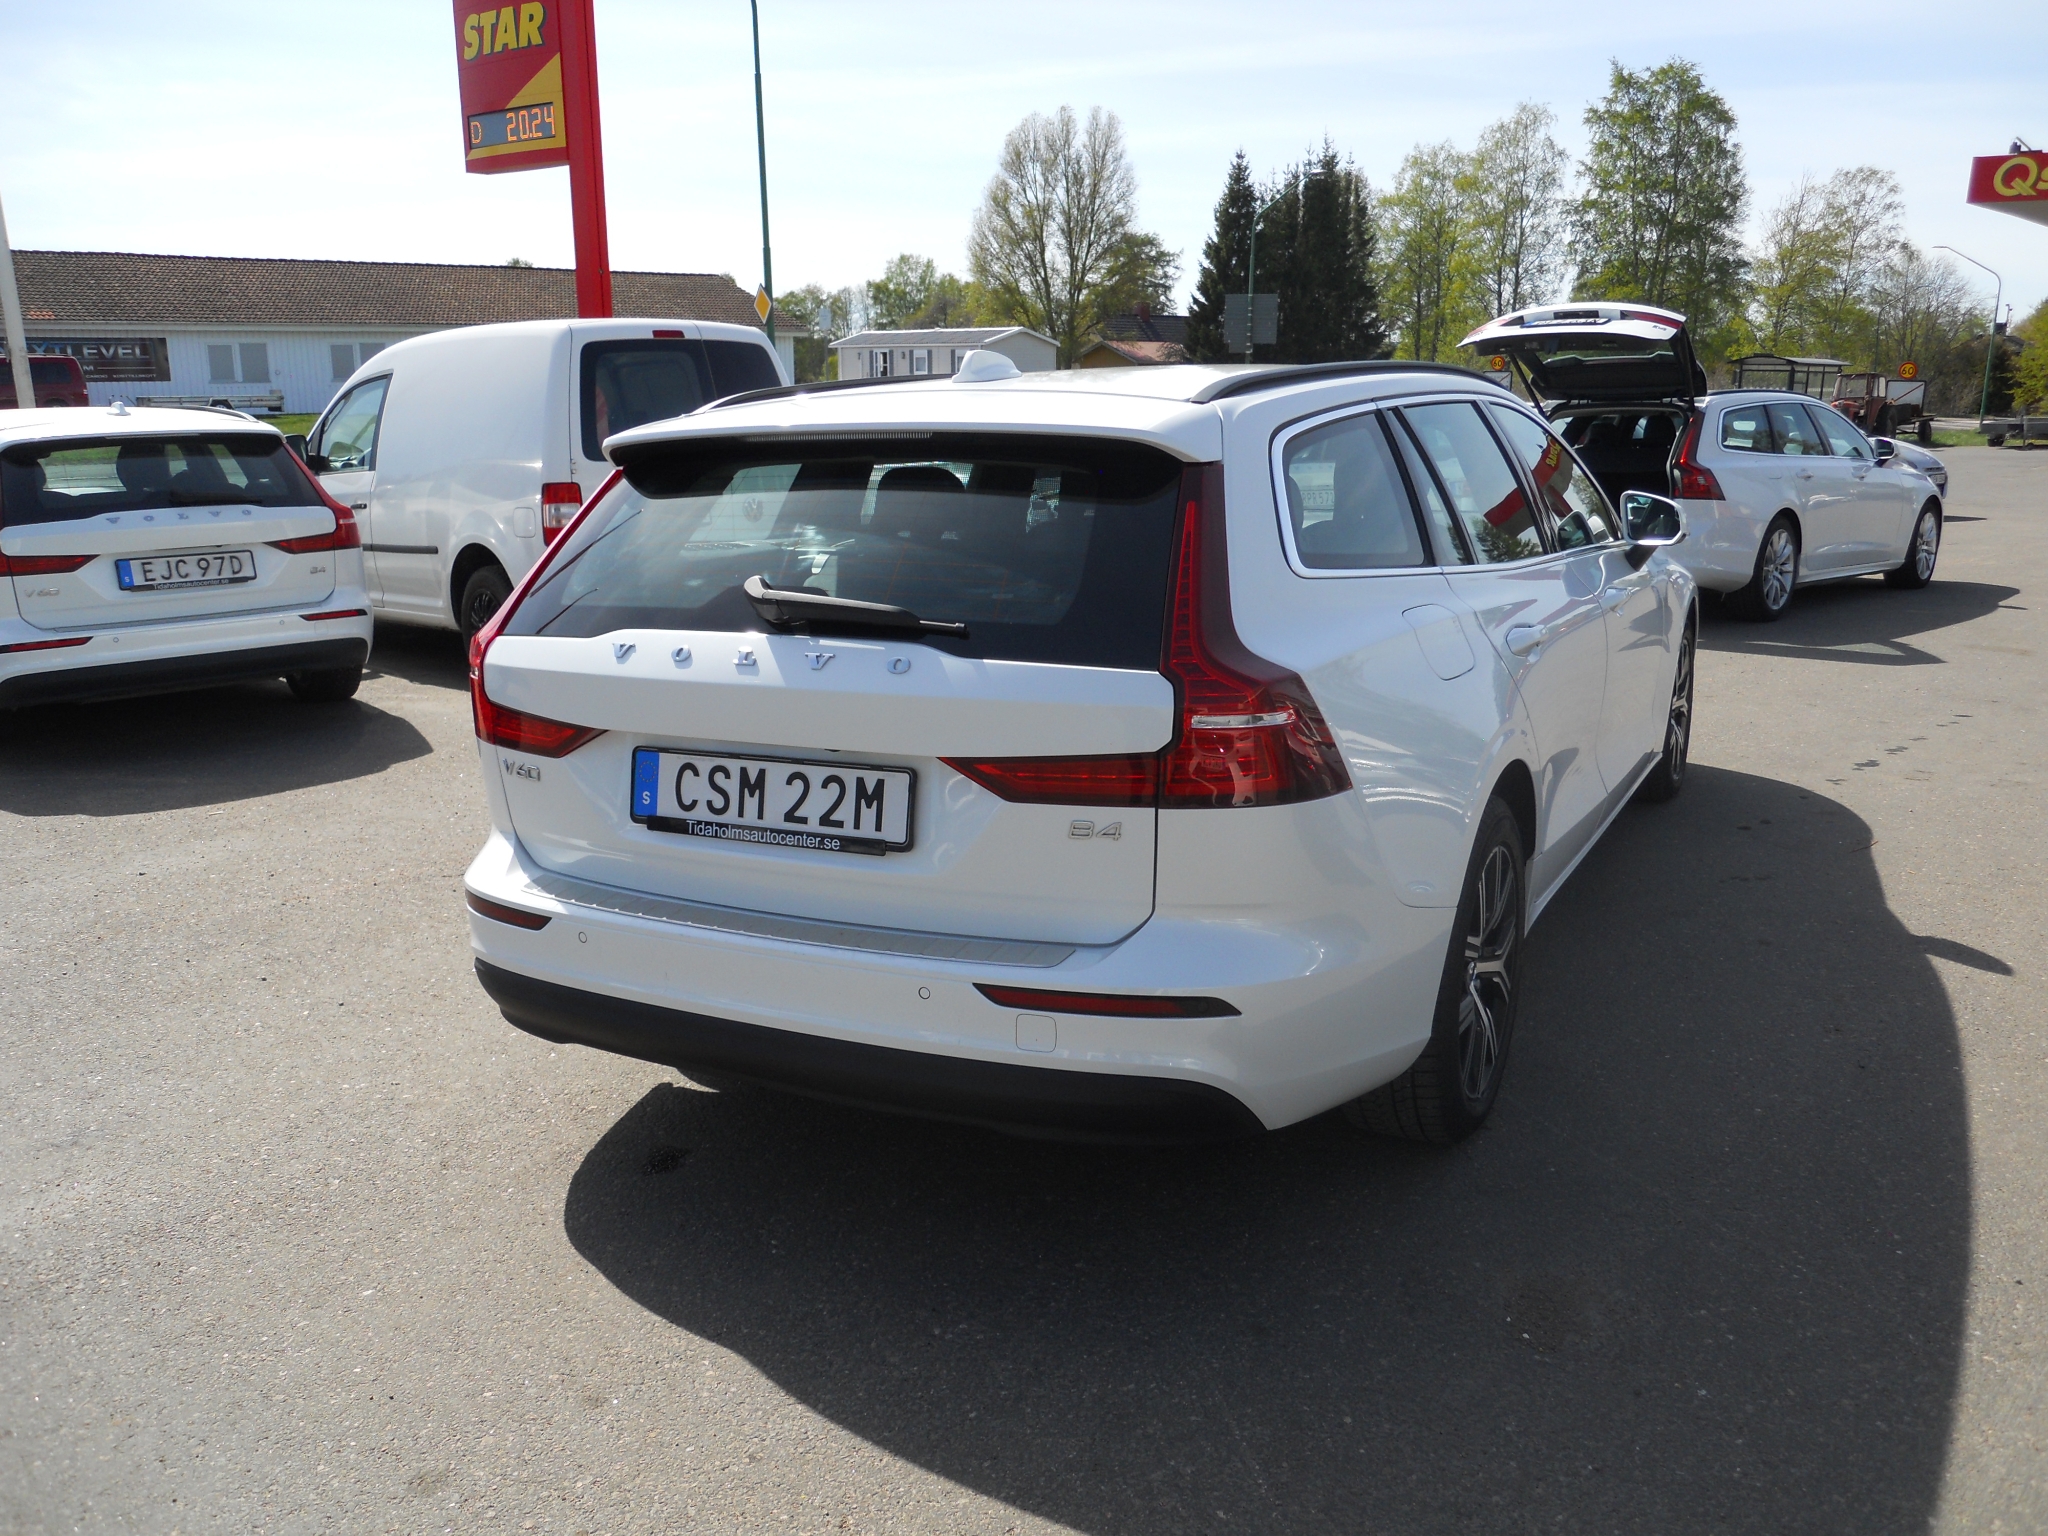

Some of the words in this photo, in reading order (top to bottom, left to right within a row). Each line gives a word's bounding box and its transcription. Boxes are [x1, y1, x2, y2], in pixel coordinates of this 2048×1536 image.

[463, 2, 545, 61] STAR
[470, 121, 482, 144] D
[1901, 366, 1915, 375] 60
[105, 509, 252, 524] VOLVO
[142, 559, 189, 583] EJC
[197, 556, 243, 578] 97D
[153, 578, 230, 590] Tidaholmsautocenter.se
[612, 642, 912, 675] VOLVO
[503, 758, 541, 781] V60
[642, 791, 651, 805] S
[675, 762, 766, 820] CSM
[783, 771, 885, 833] 22M
[686, 820, 841, 851] Tidaholmsautocenter.se
[1068, 819, 1123, 841] B4
